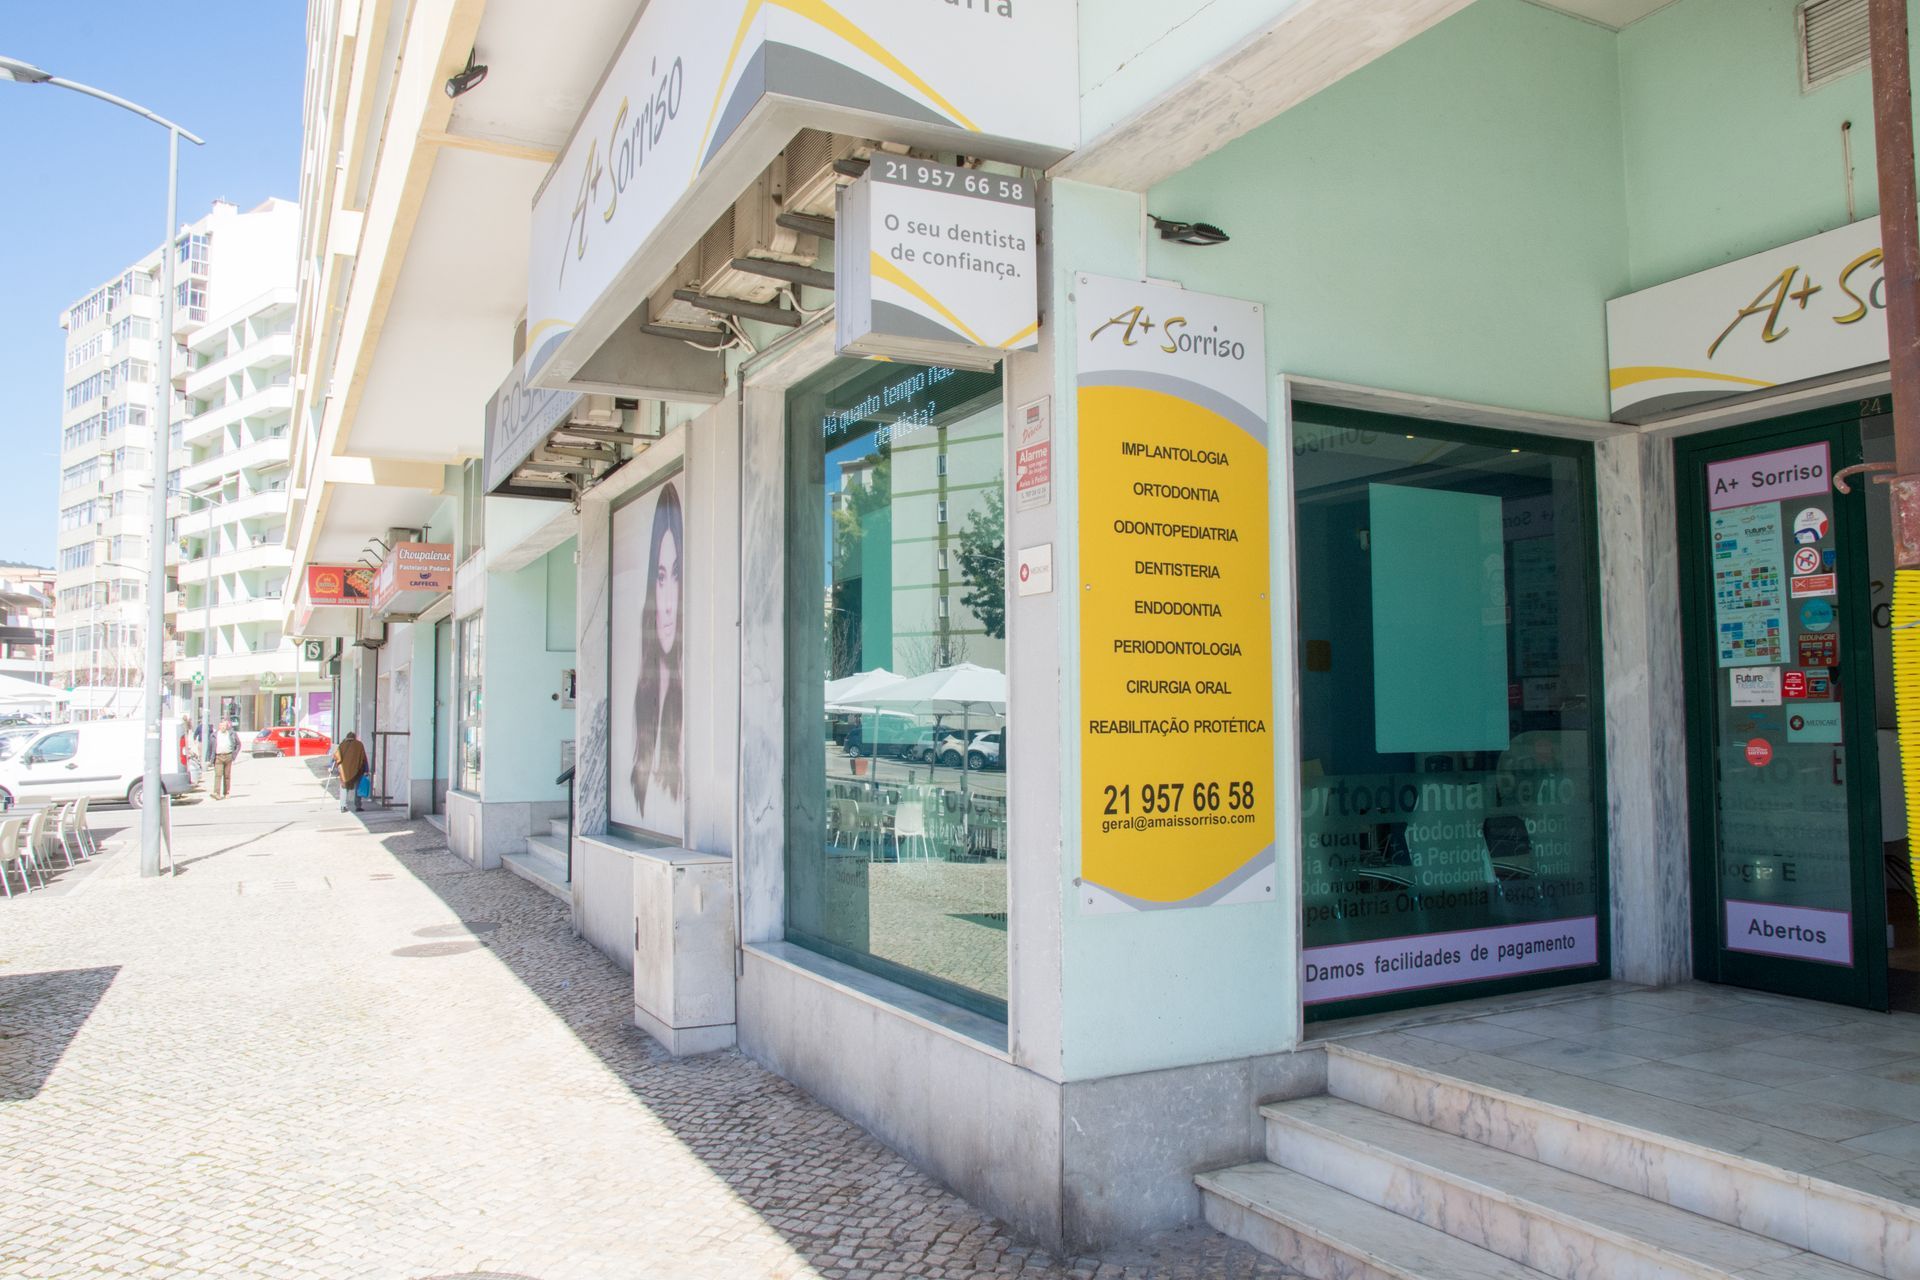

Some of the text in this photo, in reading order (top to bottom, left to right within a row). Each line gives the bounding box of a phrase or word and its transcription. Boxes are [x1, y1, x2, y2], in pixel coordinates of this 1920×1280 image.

[603, 55, 684, 224] Sorriso
[886, 161, 1023, 200] 21 957 66 58
[884, 213, 1026, 252] O seu dentista
[890, 242, 1022, 280] de confiança.
[1707, 264, 1822, 360] A+
[1090, 305, 1244, 360] A+ Sorriso
[839, 395, 880, 434] quanto
[883, 372, 925, 407] tempo
[1859, 399, 1882, 416] 24
[873, 400, 936, 448] dentista?
[1019, 447, 1047, 464] Alarme
[1121, 441, 1229, 466] IMPLANTOLOGIA
[1715, 464, 1823, 494] A+ Sorriso
[1133, 482, 1220, 502] ORTODONTIA
[1113, 520, 1239, 542] ODONTOPEDIATRIA
[399, 548, 451, 562] Choupalense
[1135, 561, 1221, 579] DENTISTERIA
[1134, 600, 1222, 617] ENDODONTIA
[1113, 639, 1242, 657] PERIODONTOLOGIA
[1126, 680, 1232, 695] CIRURGIA ORAL
[1736, 674, 1763, 684] Future
[1089, 716, 1266, 737] REABILITAÇÃO PROTÉTICA
[1103, 781, 1255, 815] 21 957 66 58
[1101, 812, 1256, 833] geral@amaissorriso.com
[1396, 886, 1488, 913] Ortodontia
[1748, 918, 1826, 944] Abertos
[1305, 934, 1576, 983] Damos facilidades de pagamento
